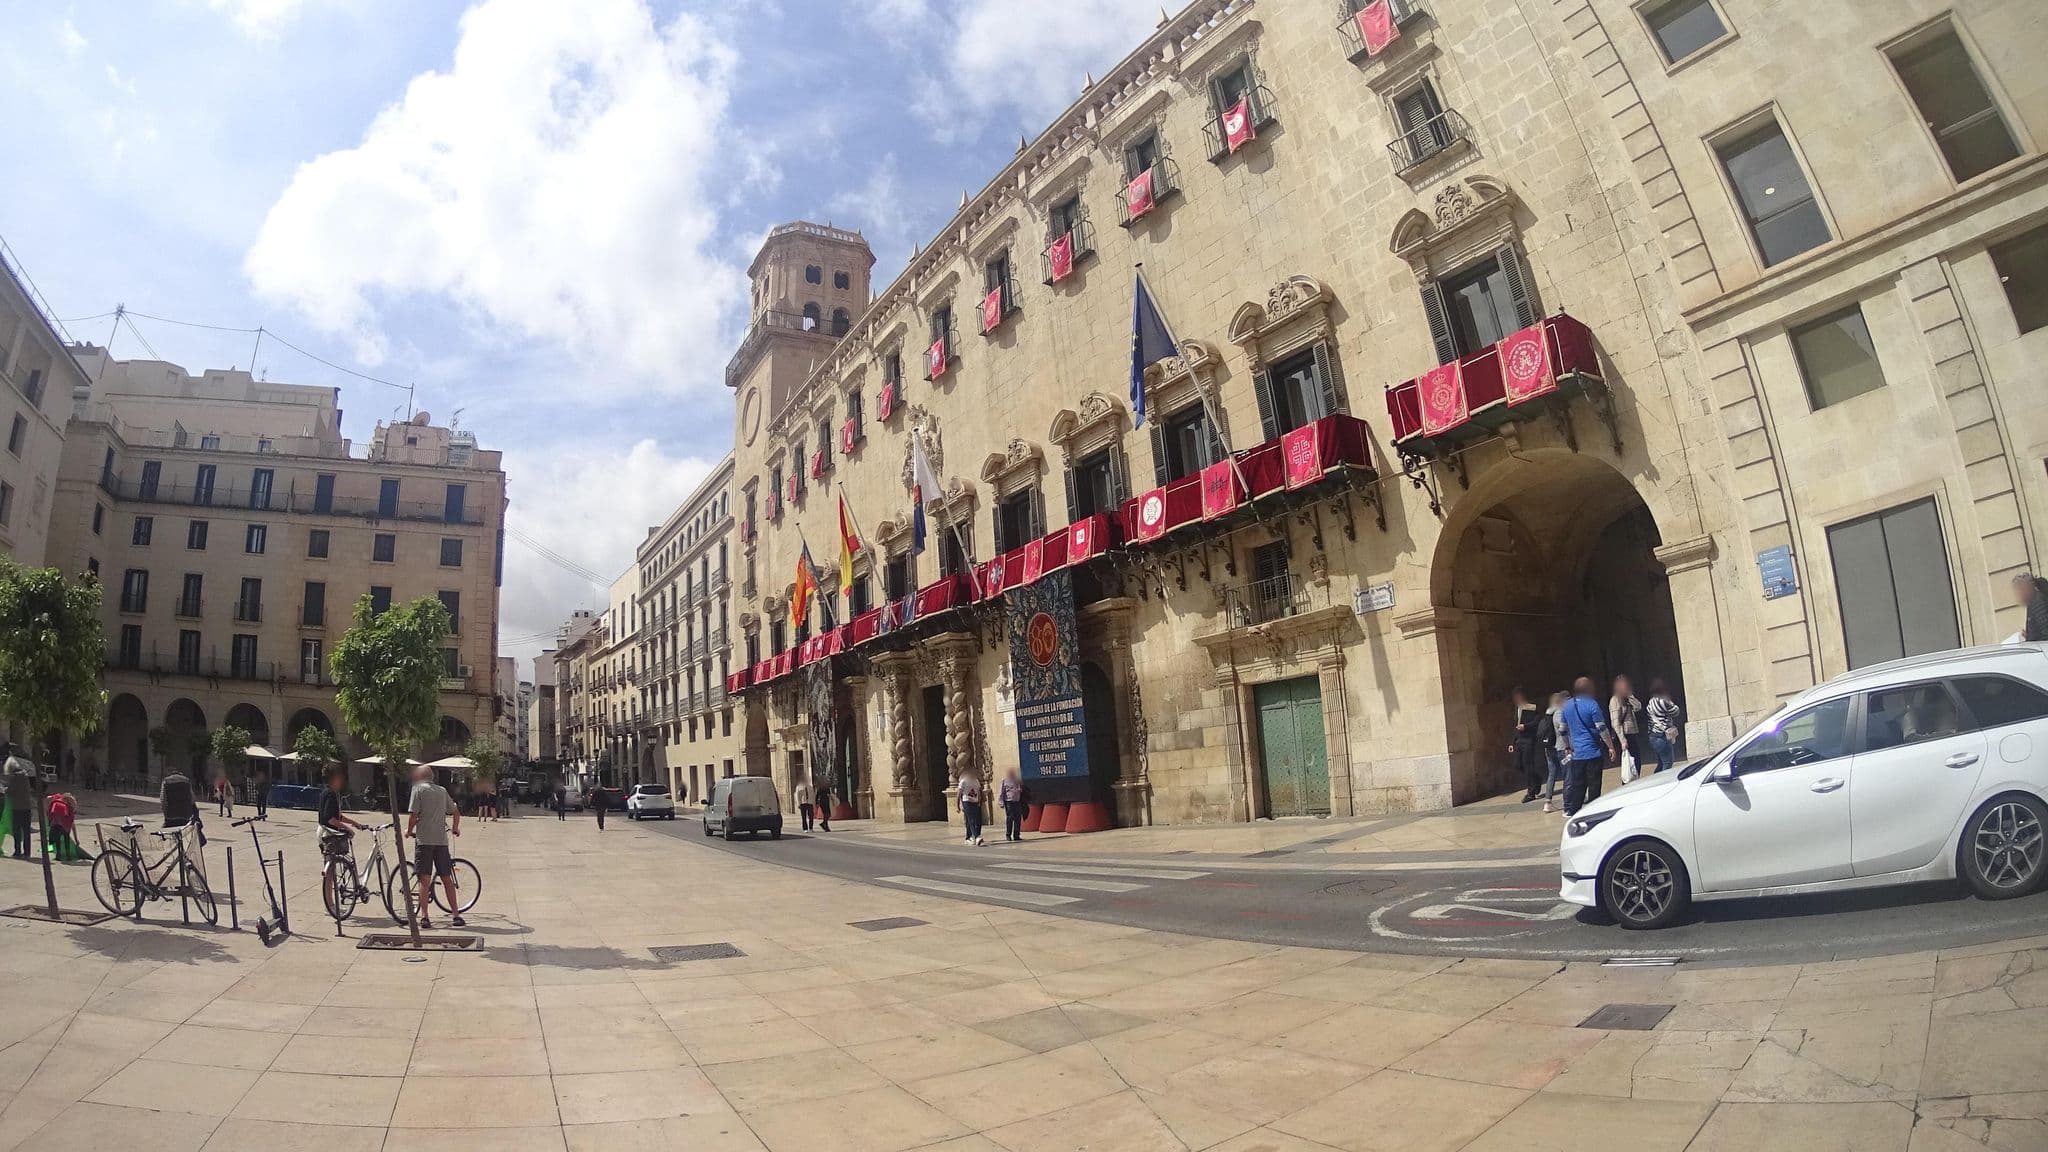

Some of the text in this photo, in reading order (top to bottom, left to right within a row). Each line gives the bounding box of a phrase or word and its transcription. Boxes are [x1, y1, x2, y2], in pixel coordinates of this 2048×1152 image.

[1031, 622, 1054, 659] 80
[1016, 705, 1043, 717] ANIVERSARIO
[1044, 704, 1050, 713] DE
[1051, 702, 1056, 712] LA
[1026, 719, 1031, 728] DE
[1067, 712, 1073, 722] DE
[1021, 728, 1052, 740] HERMANDADES
[1030, 738, 1075, 752] DE LA SEMANA SANTA
[1039, 752, 1066, 763] DE ALICANTE
[1040, 766, 1051, 775] 1944
[1054, 765, 1066, 774] 2024
